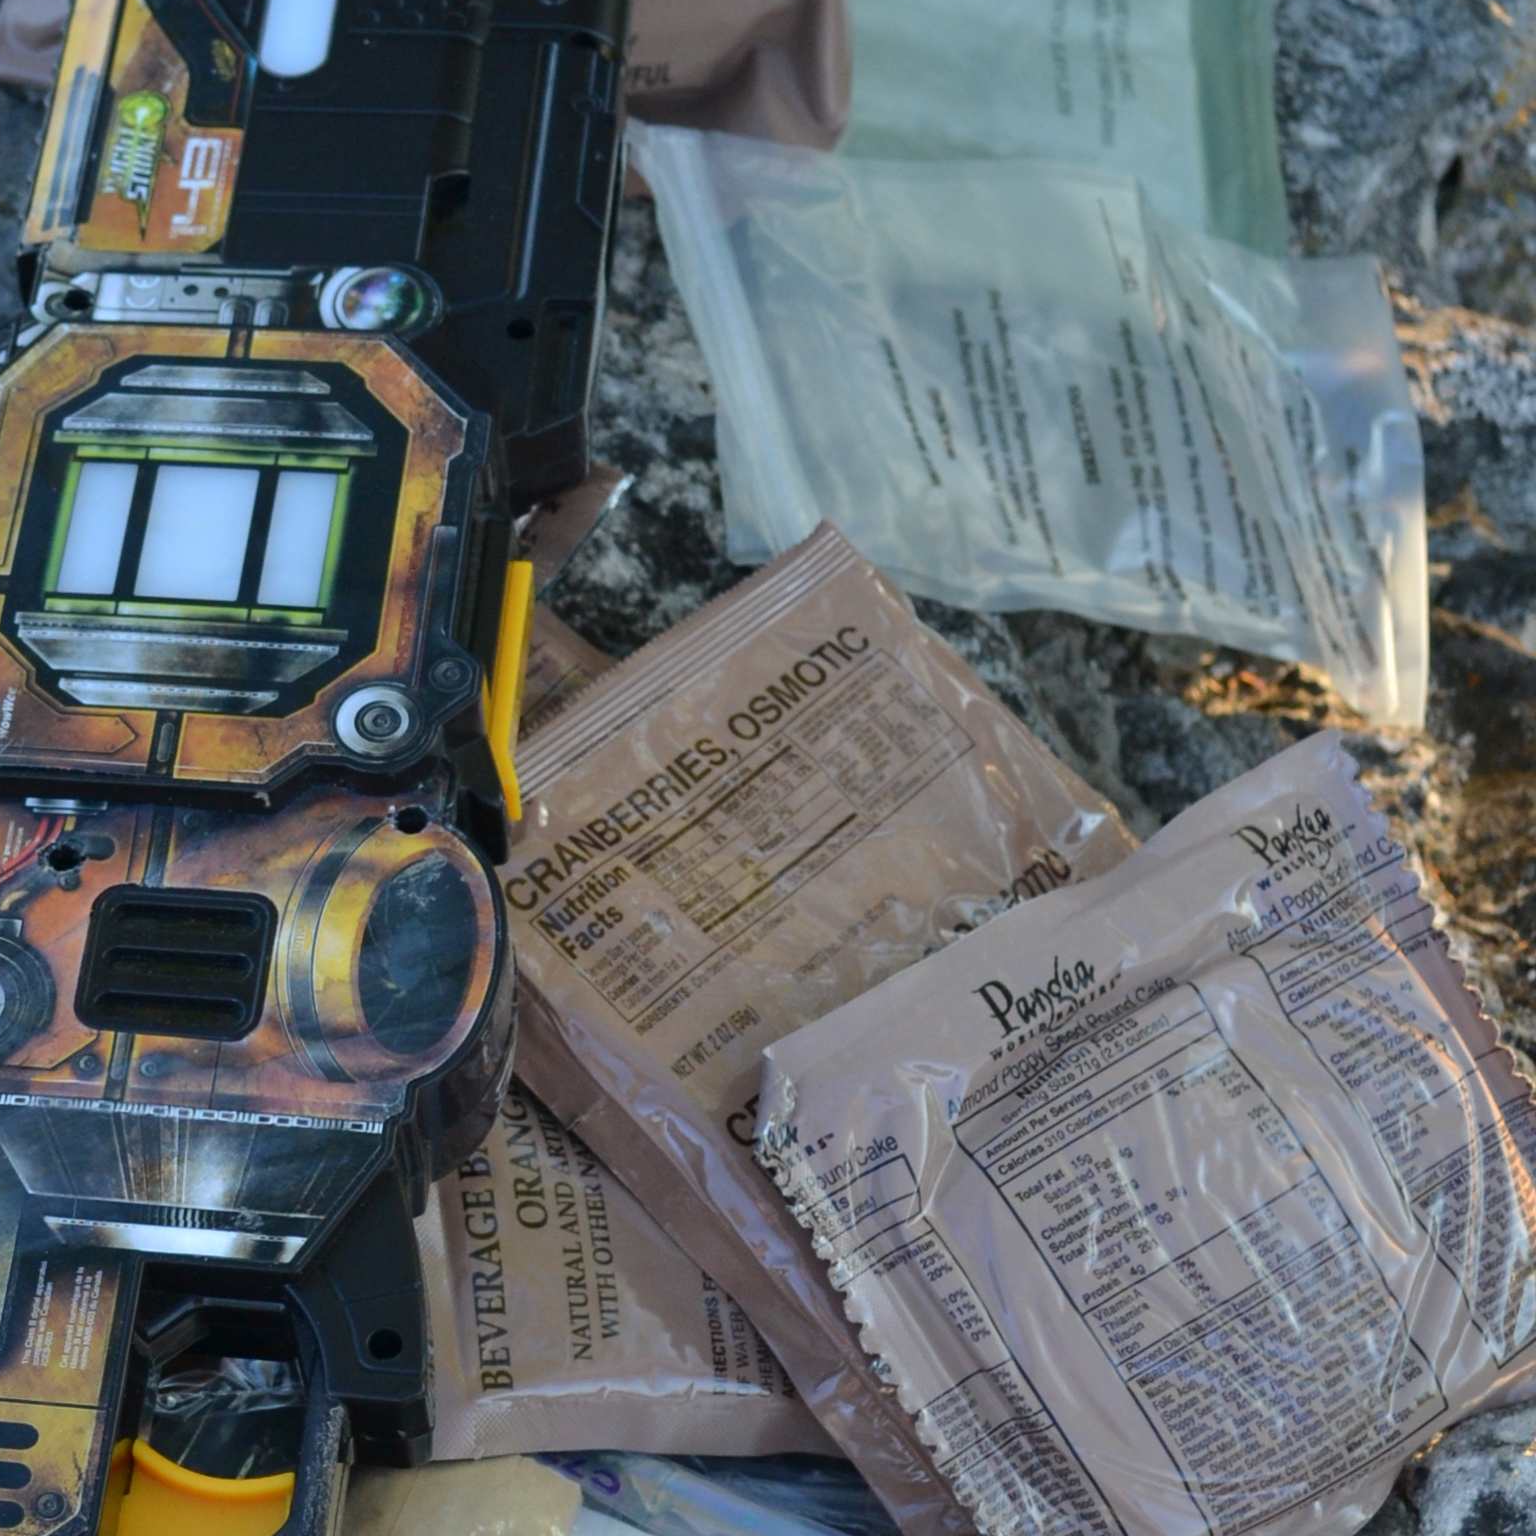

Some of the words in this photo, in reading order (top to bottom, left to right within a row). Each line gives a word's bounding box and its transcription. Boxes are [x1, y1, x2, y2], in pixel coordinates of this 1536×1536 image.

[498, 737, 742, 912] CRANBERRIES,
[726, 625, 873, 741] OSMOTIC
[532, 865, 632, 940] Nutrition
[557, 906, 625, 961] Facts
[947, 1073, 999, 1120] Almond
[1001, 1048, 1050, 1086] Poppy
[1043, 1021, 1088, 1054] Seed
[1084, 993, 1137, 1030] Pound
[1012, 1040, 1096, 1101] Nutrition
[1087, 1011, 1139, 1049] Facts
[849, 1127, 902, 1170] Cake
[985, 1125, 1033, 1160] Amount
[1028, 1113, 1050, 1131] Per
[553, 1181, 581, 1236] AND
[584, 1183, 614, 1267] OTHER
[461, 1188, 514, 1394] BEVERAGE
[561, 1241, 594, 1362] NATURAL
[595, 1272, 621, 1340] WITH
[729, 1312, 750, 1368] WATER
